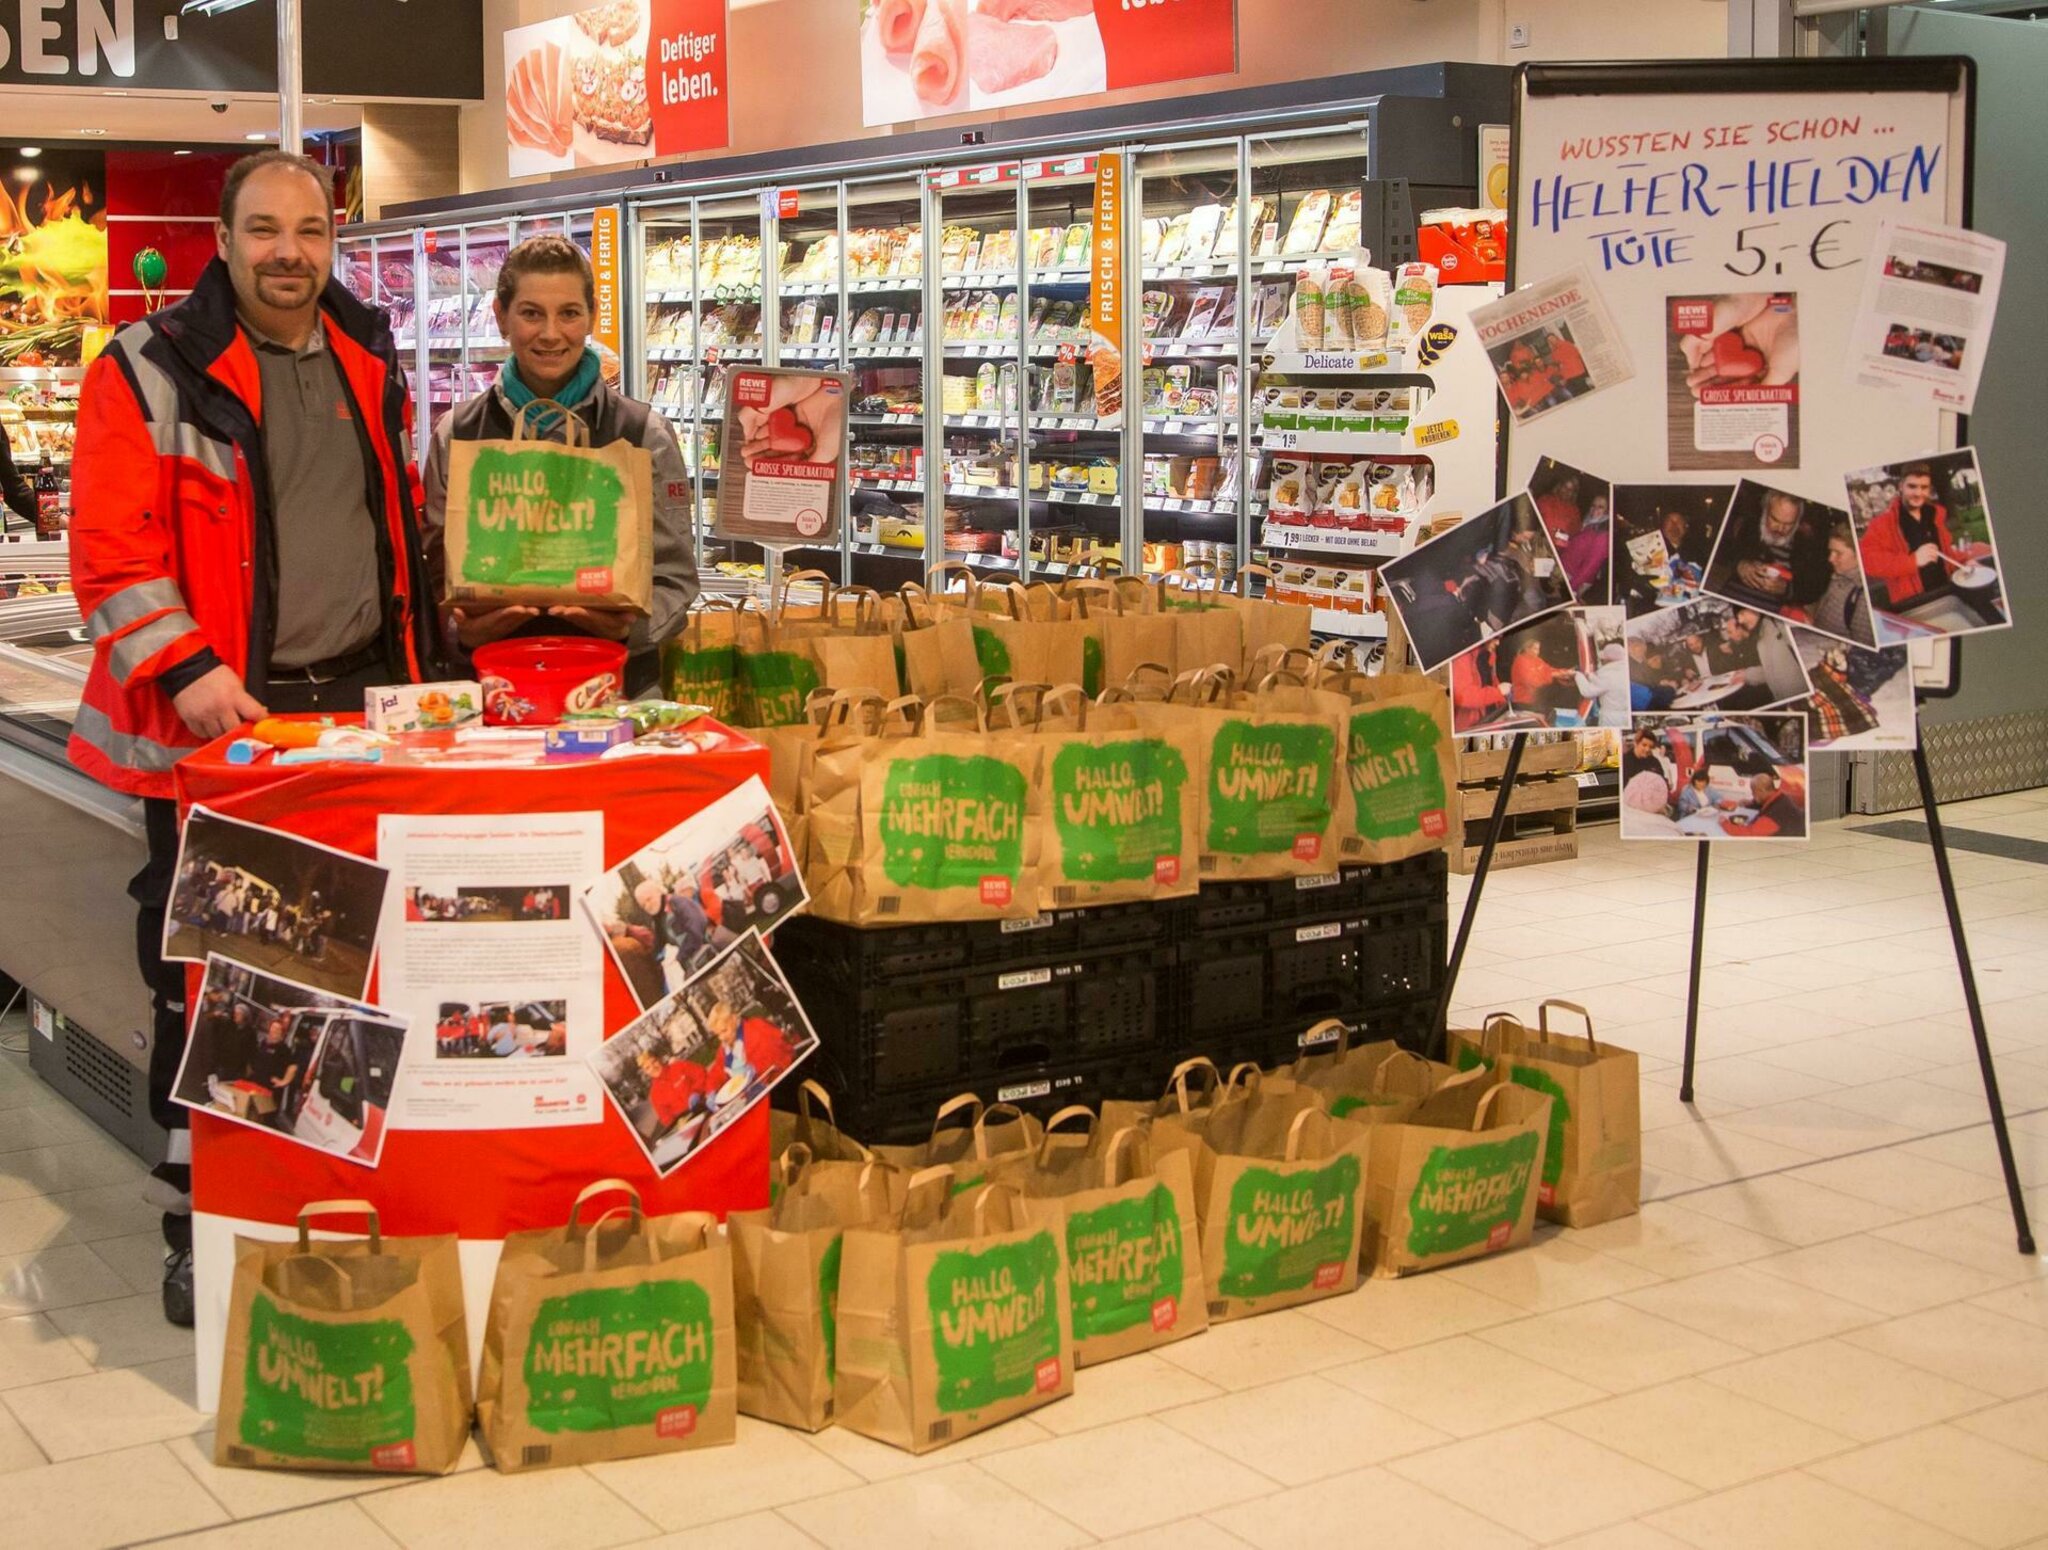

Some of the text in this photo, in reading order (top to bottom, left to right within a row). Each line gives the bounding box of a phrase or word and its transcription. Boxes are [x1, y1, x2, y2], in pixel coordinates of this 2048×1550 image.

[0, 0, 136, 77] EN
[660, 31, 717, 65] Deftiger
[661, 68, 719, 105] leben.
[1560, 131, 1690, 160] WUSSTEN
[1703, 125, 1749, 150] SIE
[1766, 116, 1861, 146] SCHON
[1101, 167, 1113, 323] FRISCH & FERTIG
[1587, 228, 1695, 271] TÜTE
[598, 218, 612, 334] FRISCH & FERTIG
[1677, 305, 1708, 315] REWE
[1428, 332, 1454, 340] wasa
[1304, 354, 1355, 369] Delicate
[739, 378, 767, 388] REWE
[1702, 389, 1730, 402] GROSSE
[1426, 422, 1444, 435] JETZT
[488, 469, 549, 497] HALLO,
[754, 462, 835, 479] GROSSE SPENDENAKTION
[477, 495, 596, 533] UMWELT!
[1283, 532, 1299, 547] 1.99
[380, 694, 399, 714] ja!
[1229, 742, 1285, 767] HALLO,
[1350, 742, 1420, 793] WELT!
[1075, 761, 1136, 791] HALLO,
[1217, 763, 1319, 802] UMWELT!
[887, 796, 1018, 843] MEHRFACH
[1063, 780, 1164, 828] UMWELT!
[1253, 1188, 1314, 1214] HALLO,
[1418, 1158, 1532, 1215] MEHRFACH
[1068, 1219, 1177, 1288] MEHRFH
[950, 1265, 1018, 1308] HALLO,
[939, 1276, 1046, 1348] UMWELT!
[533, 1320, 707, 1379] MEHRFACH
[257, 1344, 385, 1410] UMWELT!
